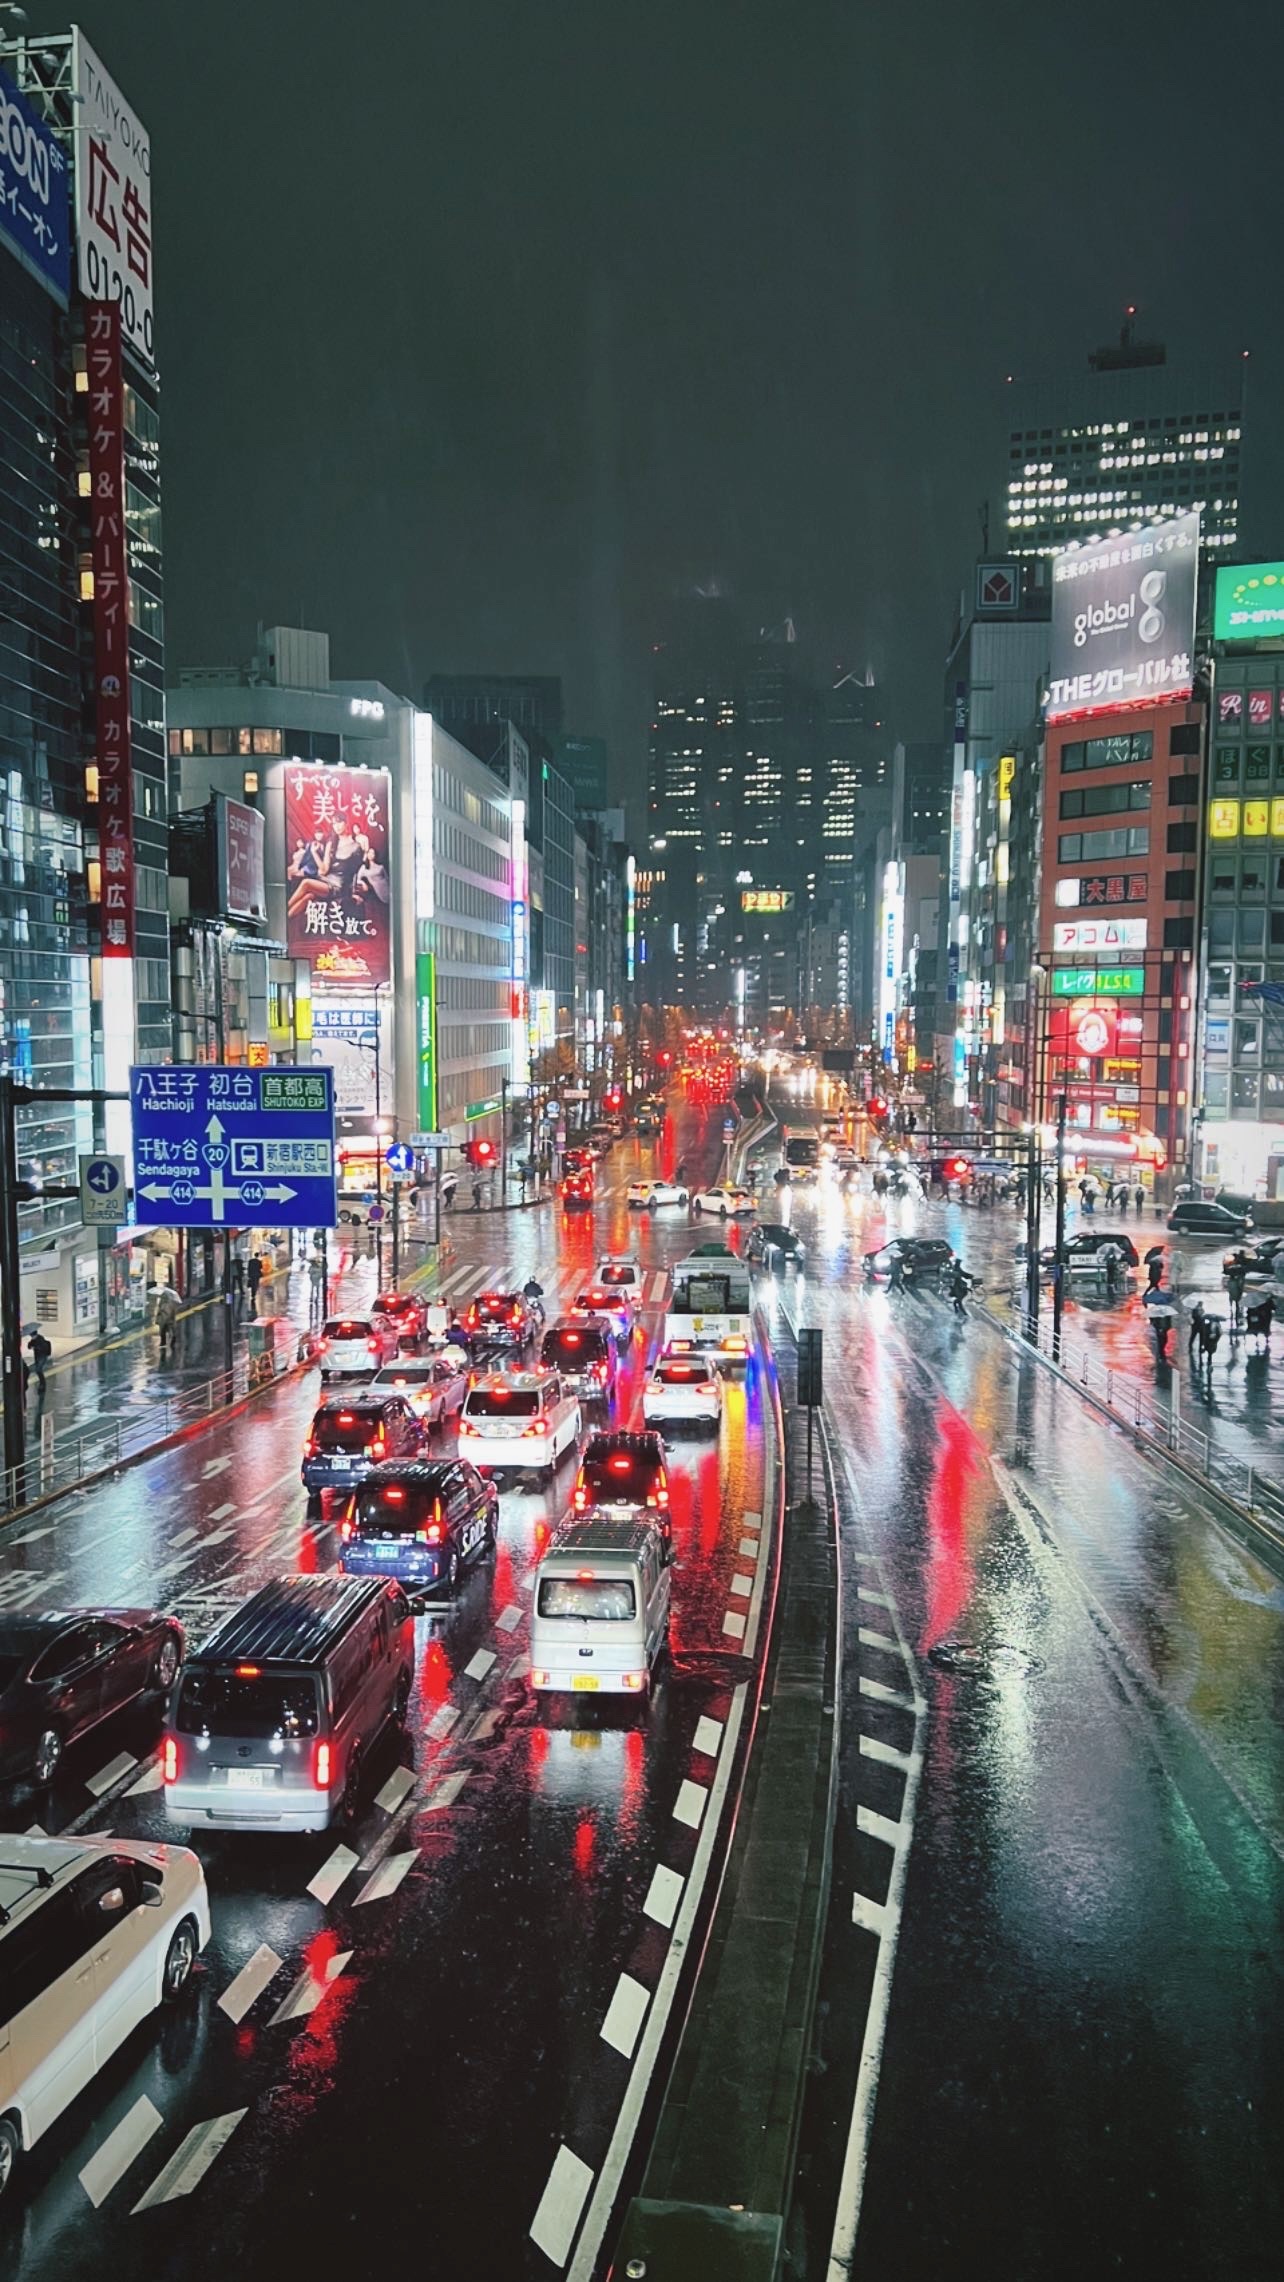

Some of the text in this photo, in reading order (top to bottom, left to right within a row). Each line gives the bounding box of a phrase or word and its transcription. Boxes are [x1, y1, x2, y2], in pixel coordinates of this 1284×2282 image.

[88, 135, 150, 290] 広告
[1074, 593, 1135, 647] global
[1049, 652, 1190, 704] THEグローバル社
[351, 698, 385, 720] FPG
[290, 771, 340, 801] すべての
[313, 790, 384, 831] 美しさを、
[103, 718, 128, 946] カラオケ歌広場
[1086, 874, 1147, 903] 大黒屋
[305, 899, 377, 935] 解き放て。
[1063, 925, 1119, 945] アコム
[136, 1073, 323, 1096] 八王子 初台 首都高
[142, 1097, 325, 1113] Hachioji Hatsudai SHUTOKO EXP
[209, 1148, 224, 1161] 20
[267, 1143, 328, 1161] 新宿駅西口
[137, 1162, 200, 1178] Sendagaya
[267, 1162, 301, 1175] Shinjuku
[173, 1187, 192, 1199] 414
[243, 1187, 262, 1200] 414
